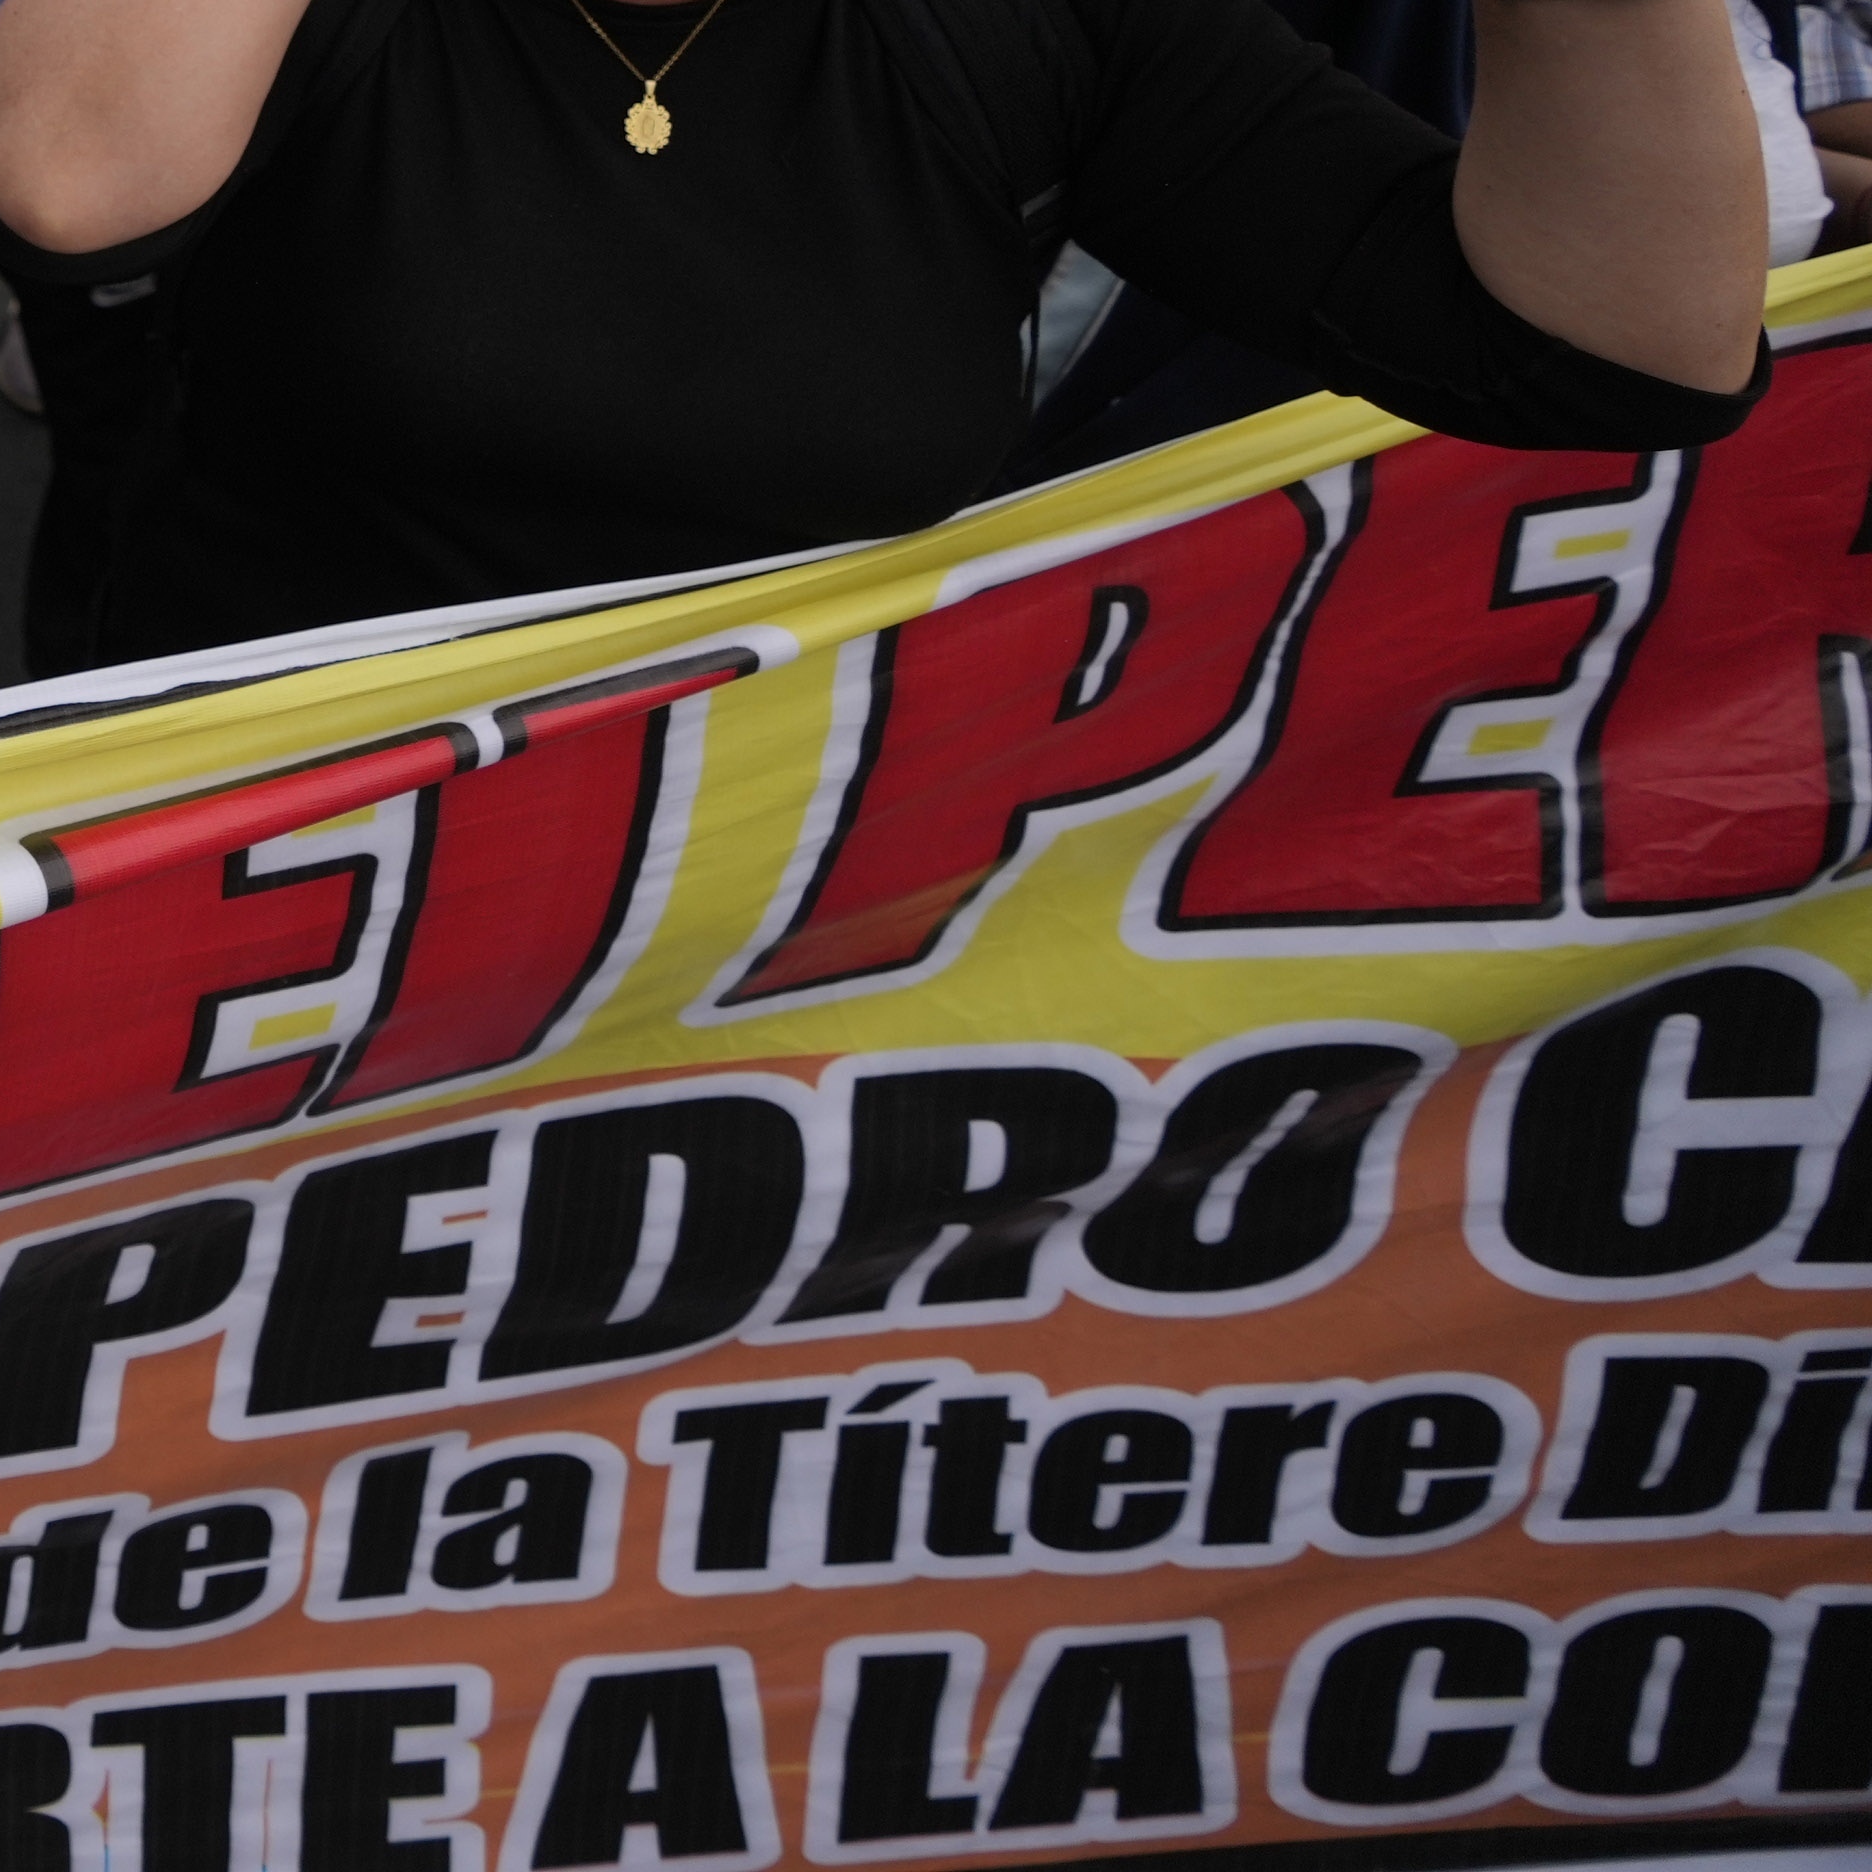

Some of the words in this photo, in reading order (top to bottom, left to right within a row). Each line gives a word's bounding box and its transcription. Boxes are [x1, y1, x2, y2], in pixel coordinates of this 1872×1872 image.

[1502, 965, 1872, 1280] C
[336, 1441, 593, 1602] la
[672, 1380, 1505, 1576] Títere
[1561, 1346, 1872, 1521] Di
[525, 1653, 749, 1866] A
[828, 1635, 1205, 1846] LA
